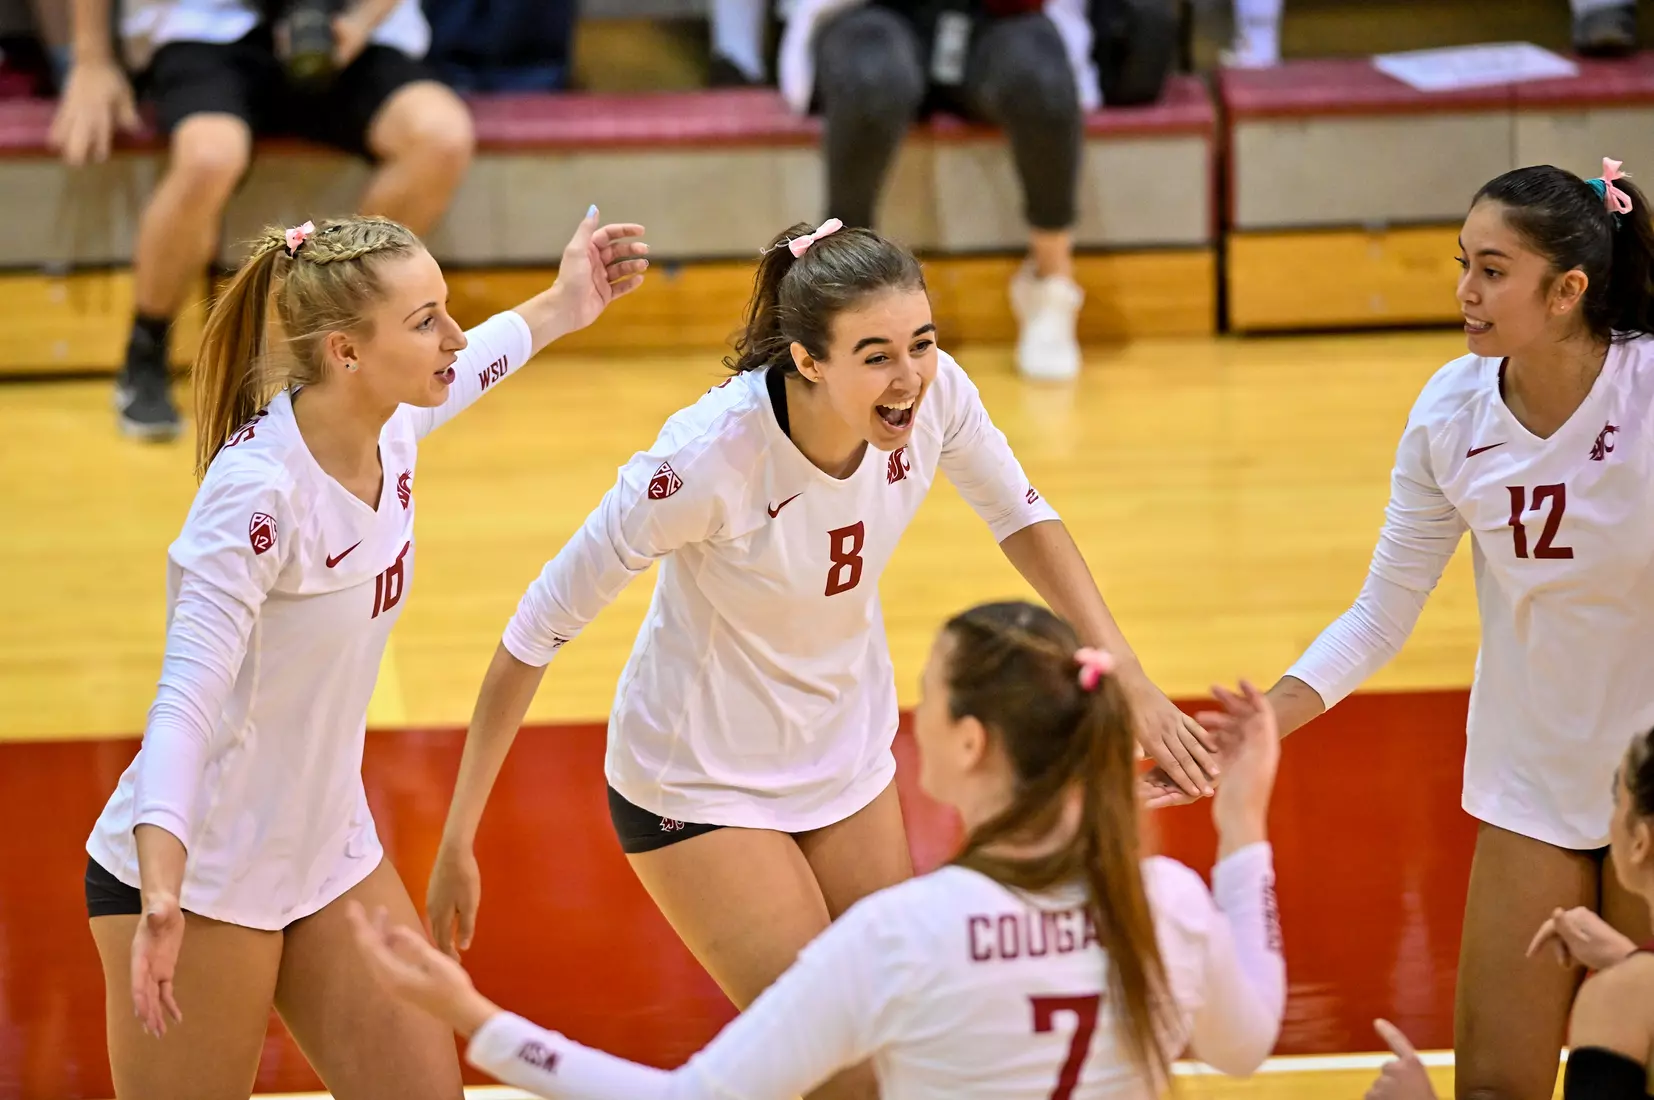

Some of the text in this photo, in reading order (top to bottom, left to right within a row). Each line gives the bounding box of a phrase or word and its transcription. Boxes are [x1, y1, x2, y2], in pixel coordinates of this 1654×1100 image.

[478, 354, 508, 391] WSU
[254, 534, 269, 550] 12
[824, 520, 865, 597] 8
[1505, 482, 1574, 559] 12
[371, 540, 411, 619] 16
[1027, 994, 1101, 1100] 7
